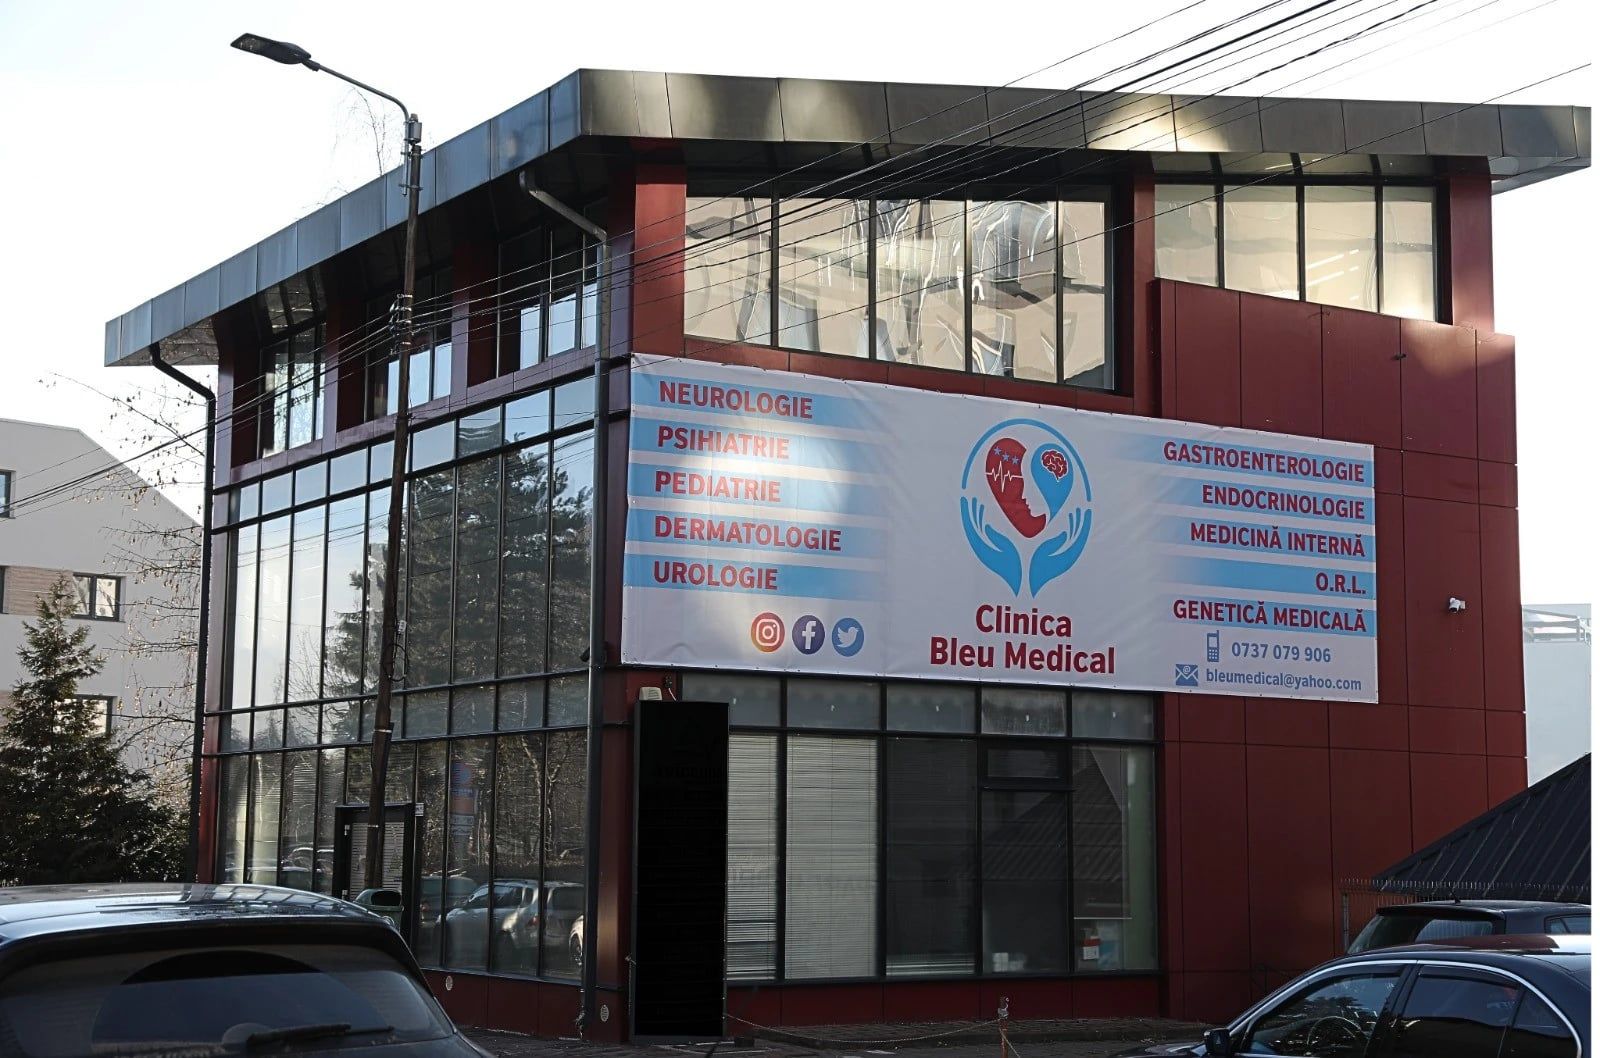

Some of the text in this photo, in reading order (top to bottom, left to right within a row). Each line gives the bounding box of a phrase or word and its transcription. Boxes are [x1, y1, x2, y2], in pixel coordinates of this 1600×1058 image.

[660, 381, 813, 419] NEUROLOGIE
[658, 426, 790, 460] PSIHIATRIE
[1163, 441, 1365, 483] GASTROENTEROLOGIE
[655, 471, 781, 502] PEDIATRIE
[1202, 484, 1366, 520] ENDOCRINOLOGIE
[655, 515, 842, 551] DERMATOLOGIE
[1190, 522, 1366, 557] MEDICINĂ INTERNĂ
[654, 561, 778, 590] UROLOGIE
[1315, 572, 1367, 594] O.R.L.
[975, 604, 1072, 638] Clinica
[1173, 599, 1367, 632] GENETICĂ MEDICALĂ
[930, 636, 1115, 674] Bleu Medical
[1231, 641, 1331, 663] 0737 079 906
[1206, 668, 1362, 690] bleumedical@yahoo.com
